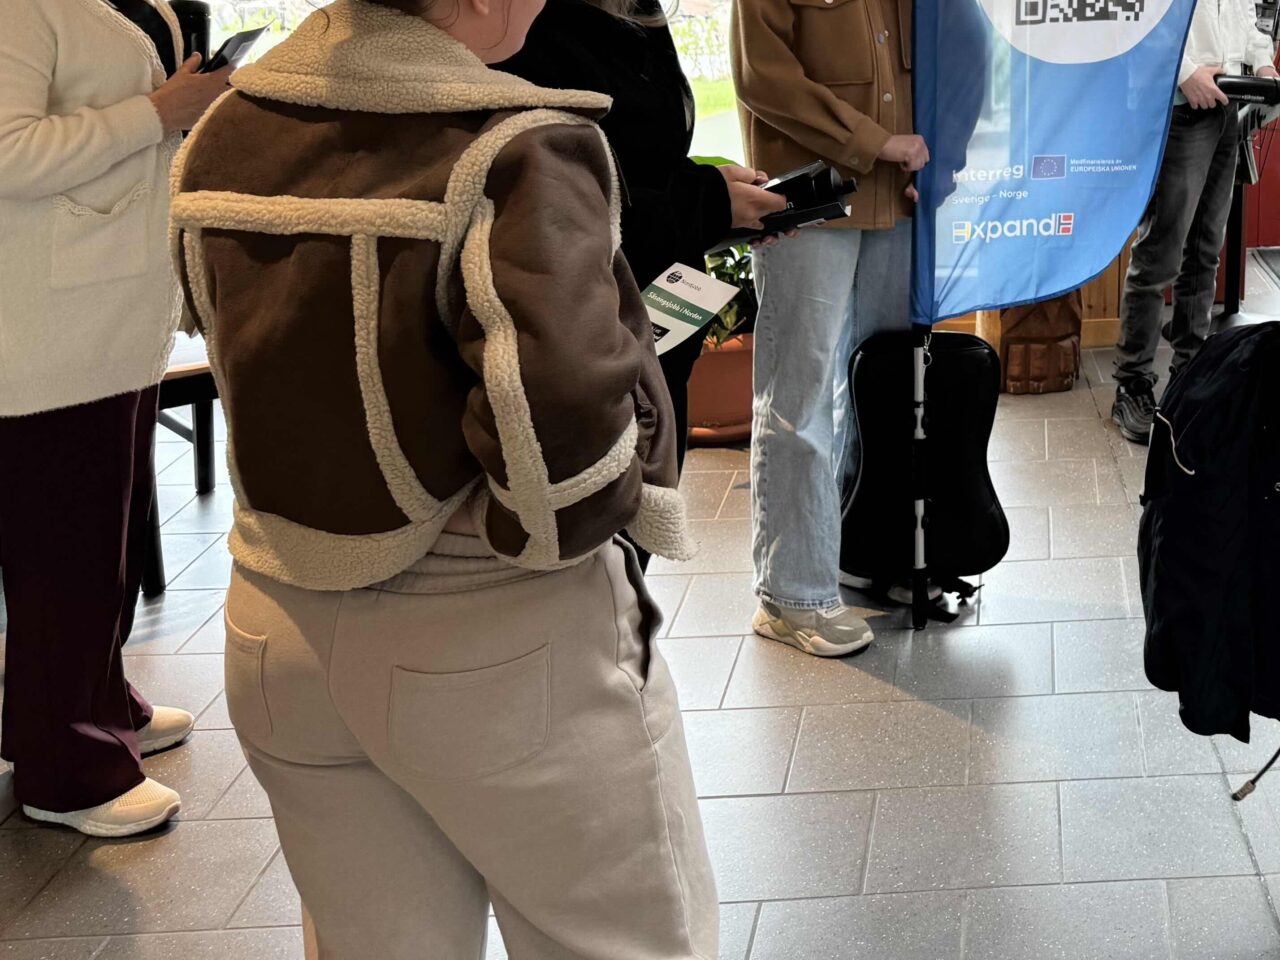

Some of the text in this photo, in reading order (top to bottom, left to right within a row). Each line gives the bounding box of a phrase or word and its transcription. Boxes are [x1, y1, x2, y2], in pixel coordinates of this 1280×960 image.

[952, 195, 991, 206] Sverige
[1000, 190, 1029, 200] Norge
[682, 307, 703, 321] Norden
